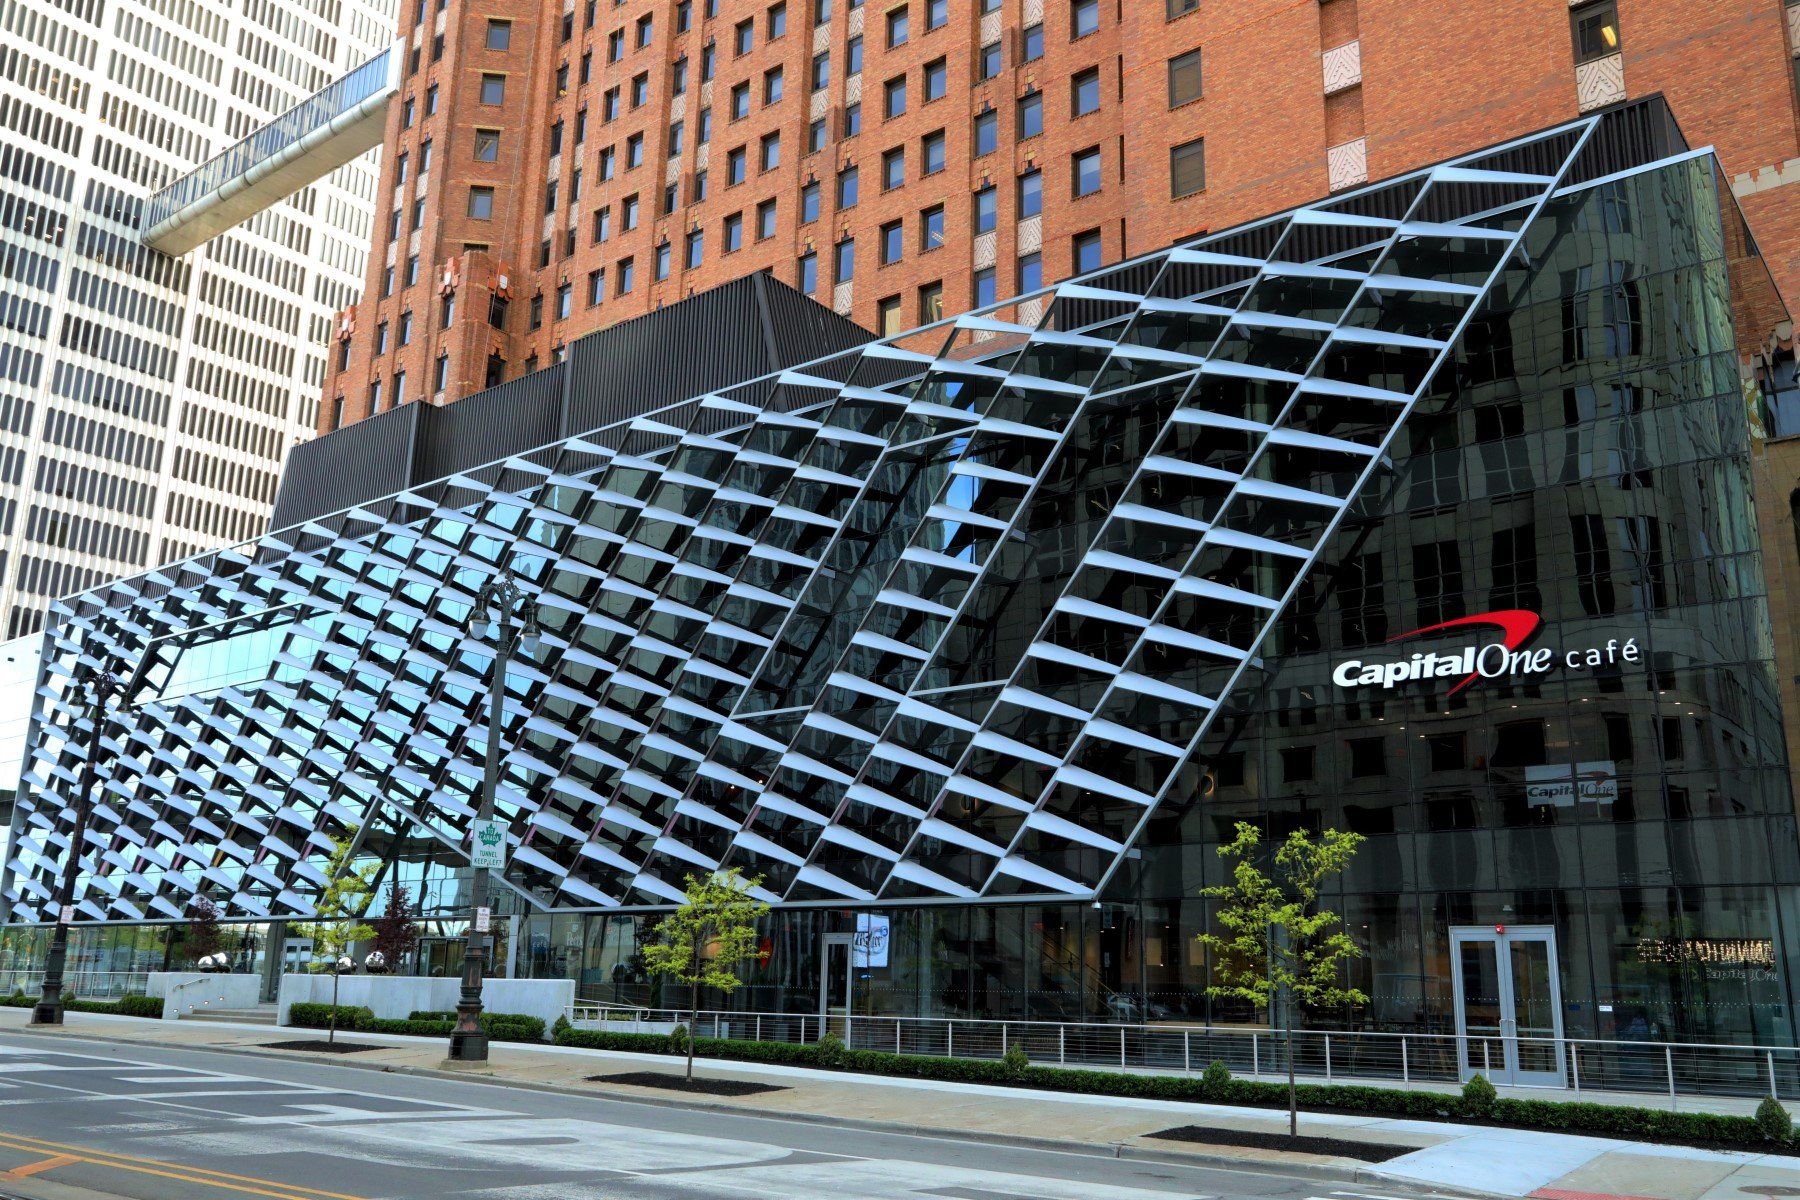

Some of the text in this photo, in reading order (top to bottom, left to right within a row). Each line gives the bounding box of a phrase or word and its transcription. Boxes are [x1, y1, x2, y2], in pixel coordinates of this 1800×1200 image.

[1566, 638, 1639, 669] café
[480, 850, 497, 858] TUNNEL
[474, 857, 502, 867] KEEP LEFT
